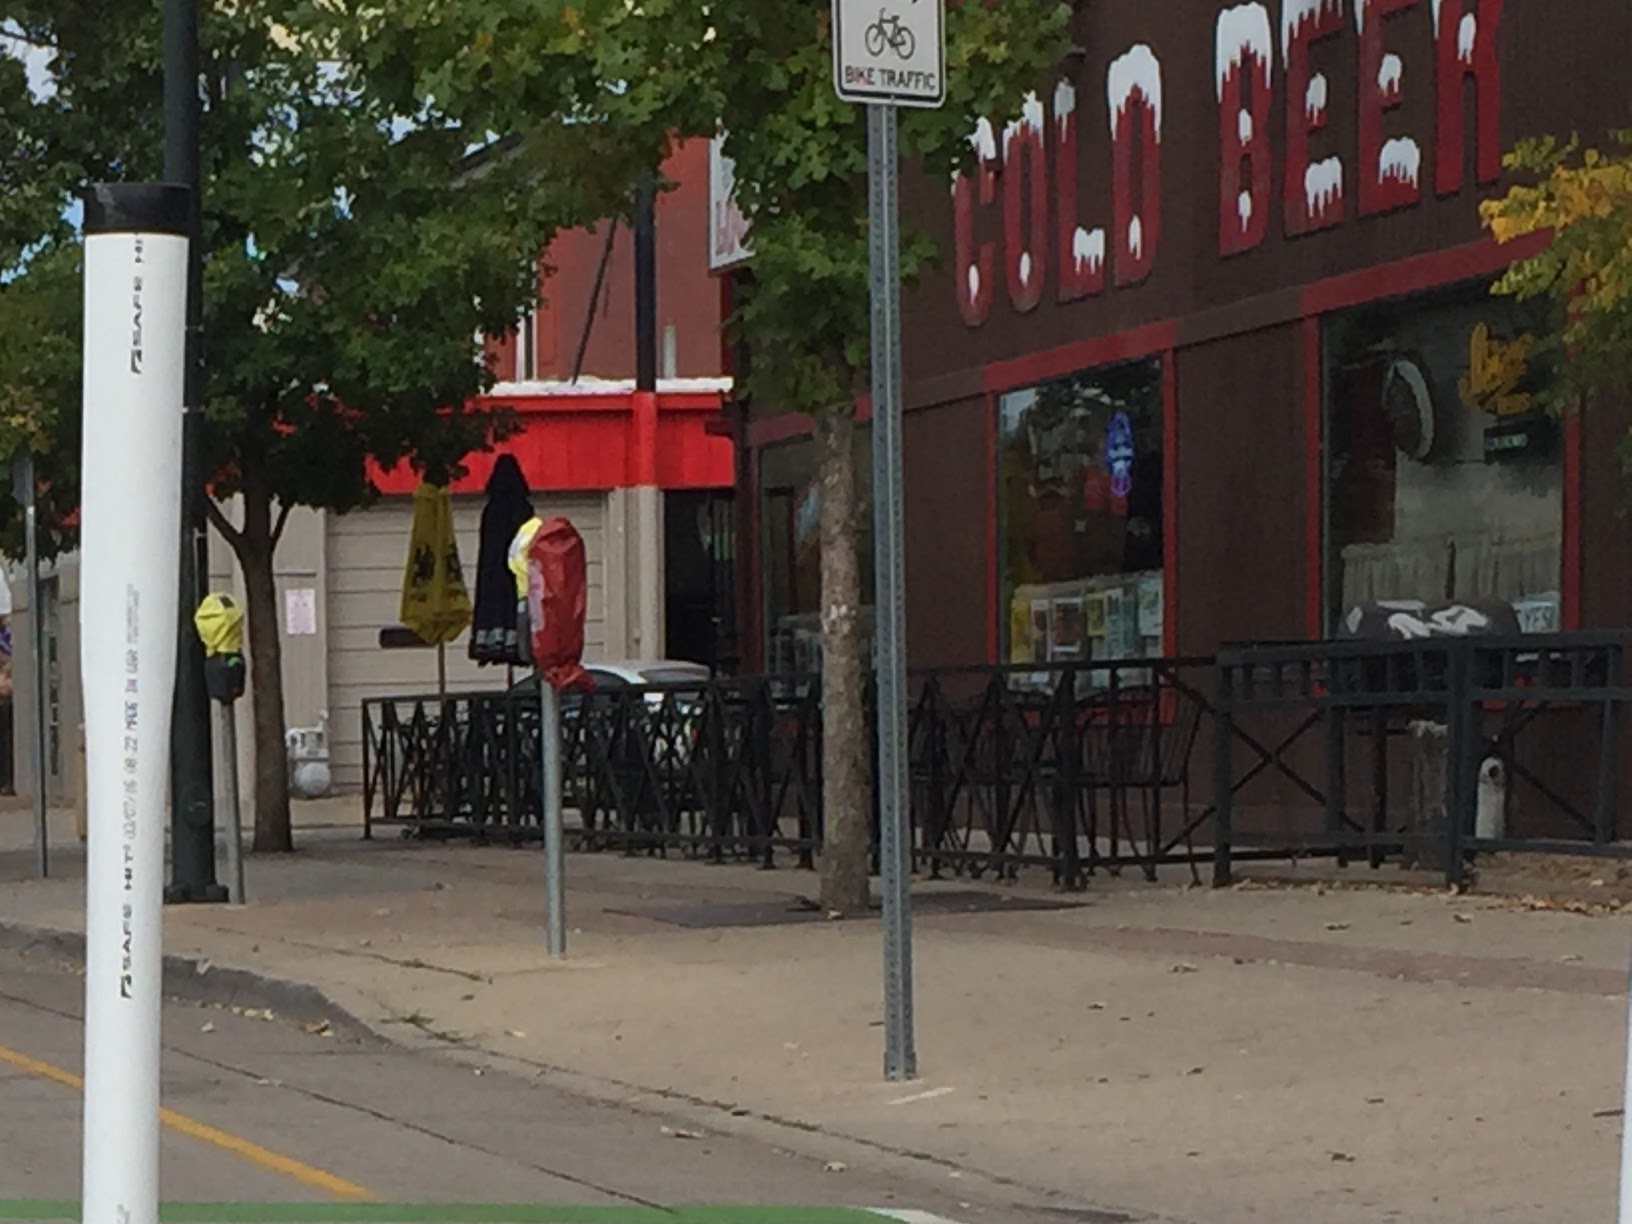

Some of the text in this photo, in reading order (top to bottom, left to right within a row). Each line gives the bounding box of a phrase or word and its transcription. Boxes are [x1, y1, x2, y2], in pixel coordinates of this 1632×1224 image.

[845, 66, 935, 91] BIKE TRAFFIC
[951, 0, 1505, 327] COLD BEER
[132, 277, 142, 347] SAFE
[124, 845, 133, 890] HIT
[122, 905, 132, 970] SAFE
